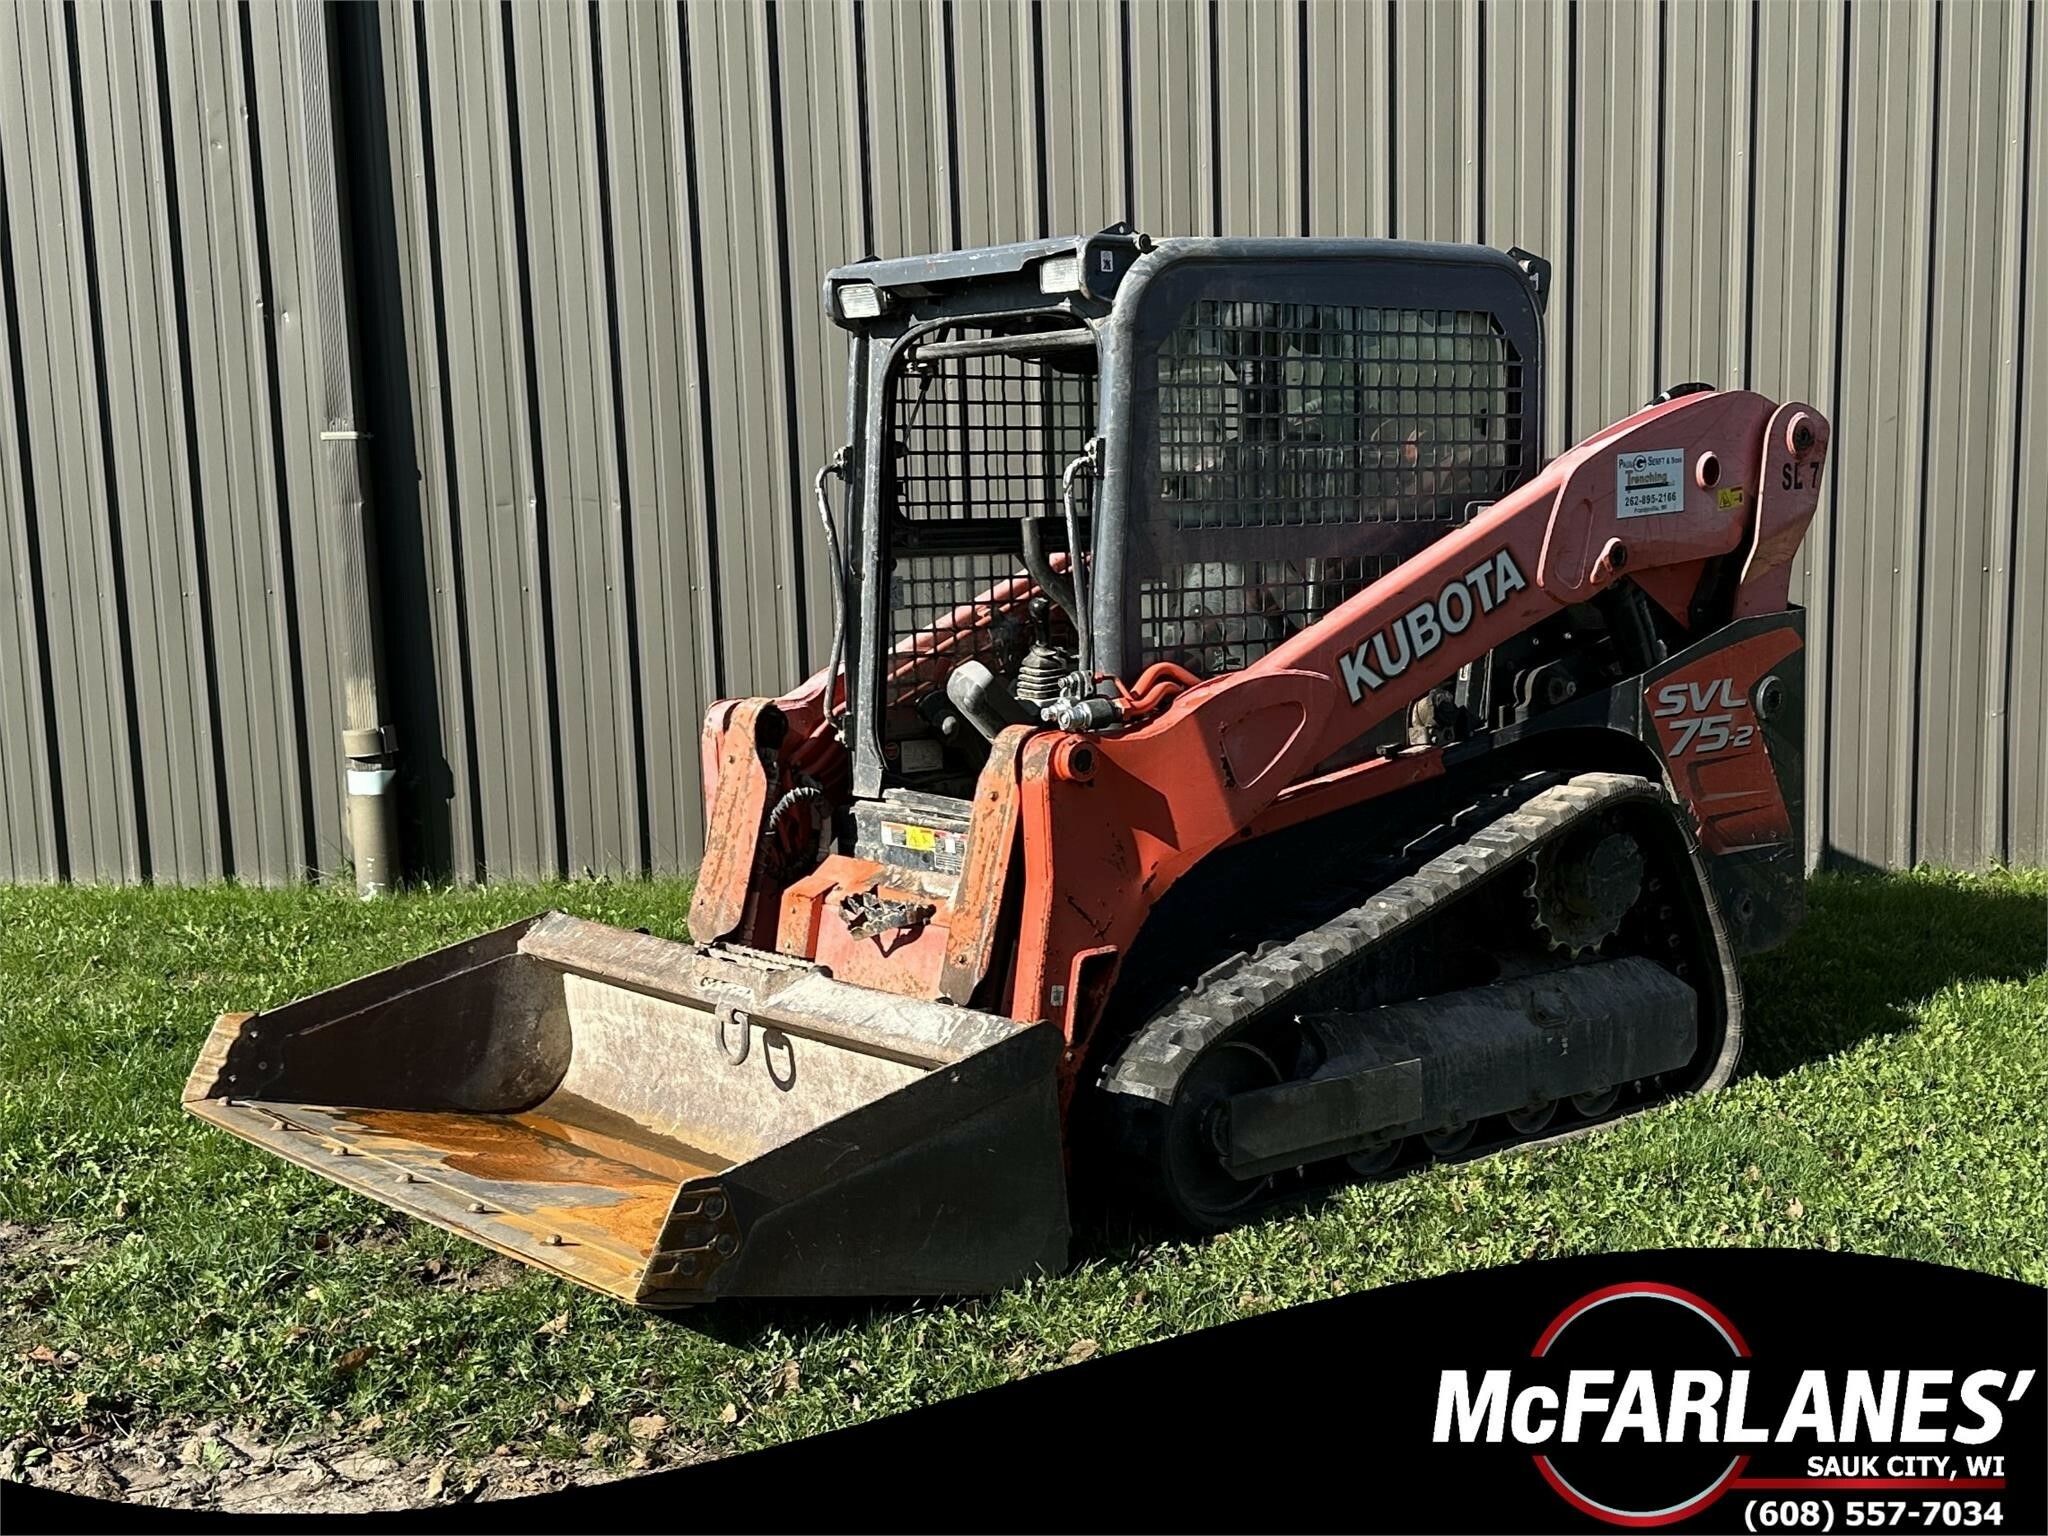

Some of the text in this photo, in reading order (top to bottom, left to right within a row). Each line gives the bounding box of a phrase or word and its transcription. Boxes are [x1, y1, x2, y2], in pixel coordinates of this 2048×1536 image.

[1781, 462, 1820, 491] SL 7
[1339, 549, 1527, 704] KUBOTA
[1654, 678, 1748, 717] SVL
[1668, 714, 1754, 757] 75-2
